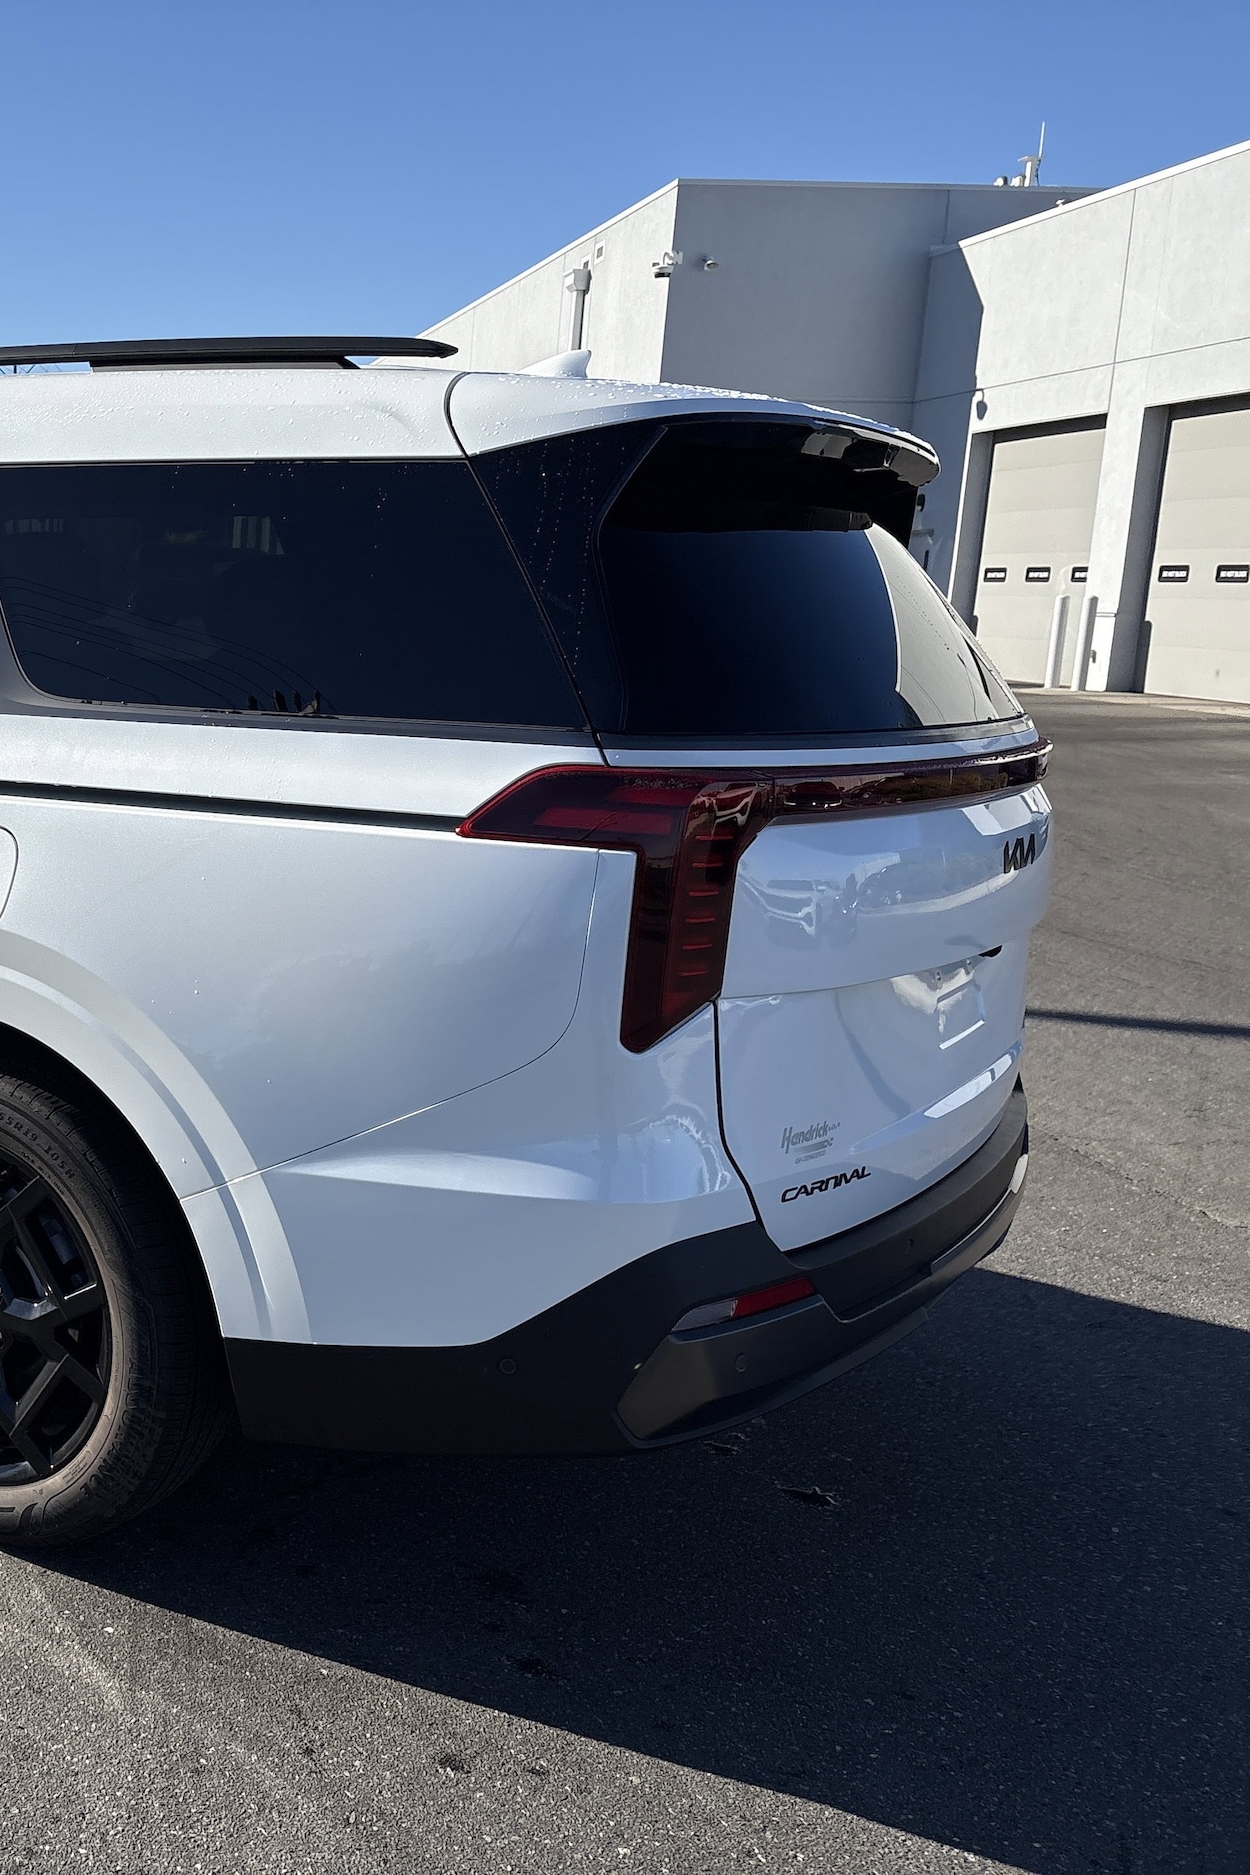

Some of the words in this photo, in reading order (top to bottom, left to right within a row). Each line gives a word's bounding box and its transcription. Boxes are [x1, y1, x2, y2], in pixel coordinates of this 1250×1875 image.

[780, 1120, 829, 1154] Hendrick
[44, 1145, 76, 1179] 105H
[781, 1166, 871, 1203] CARNIVAL
